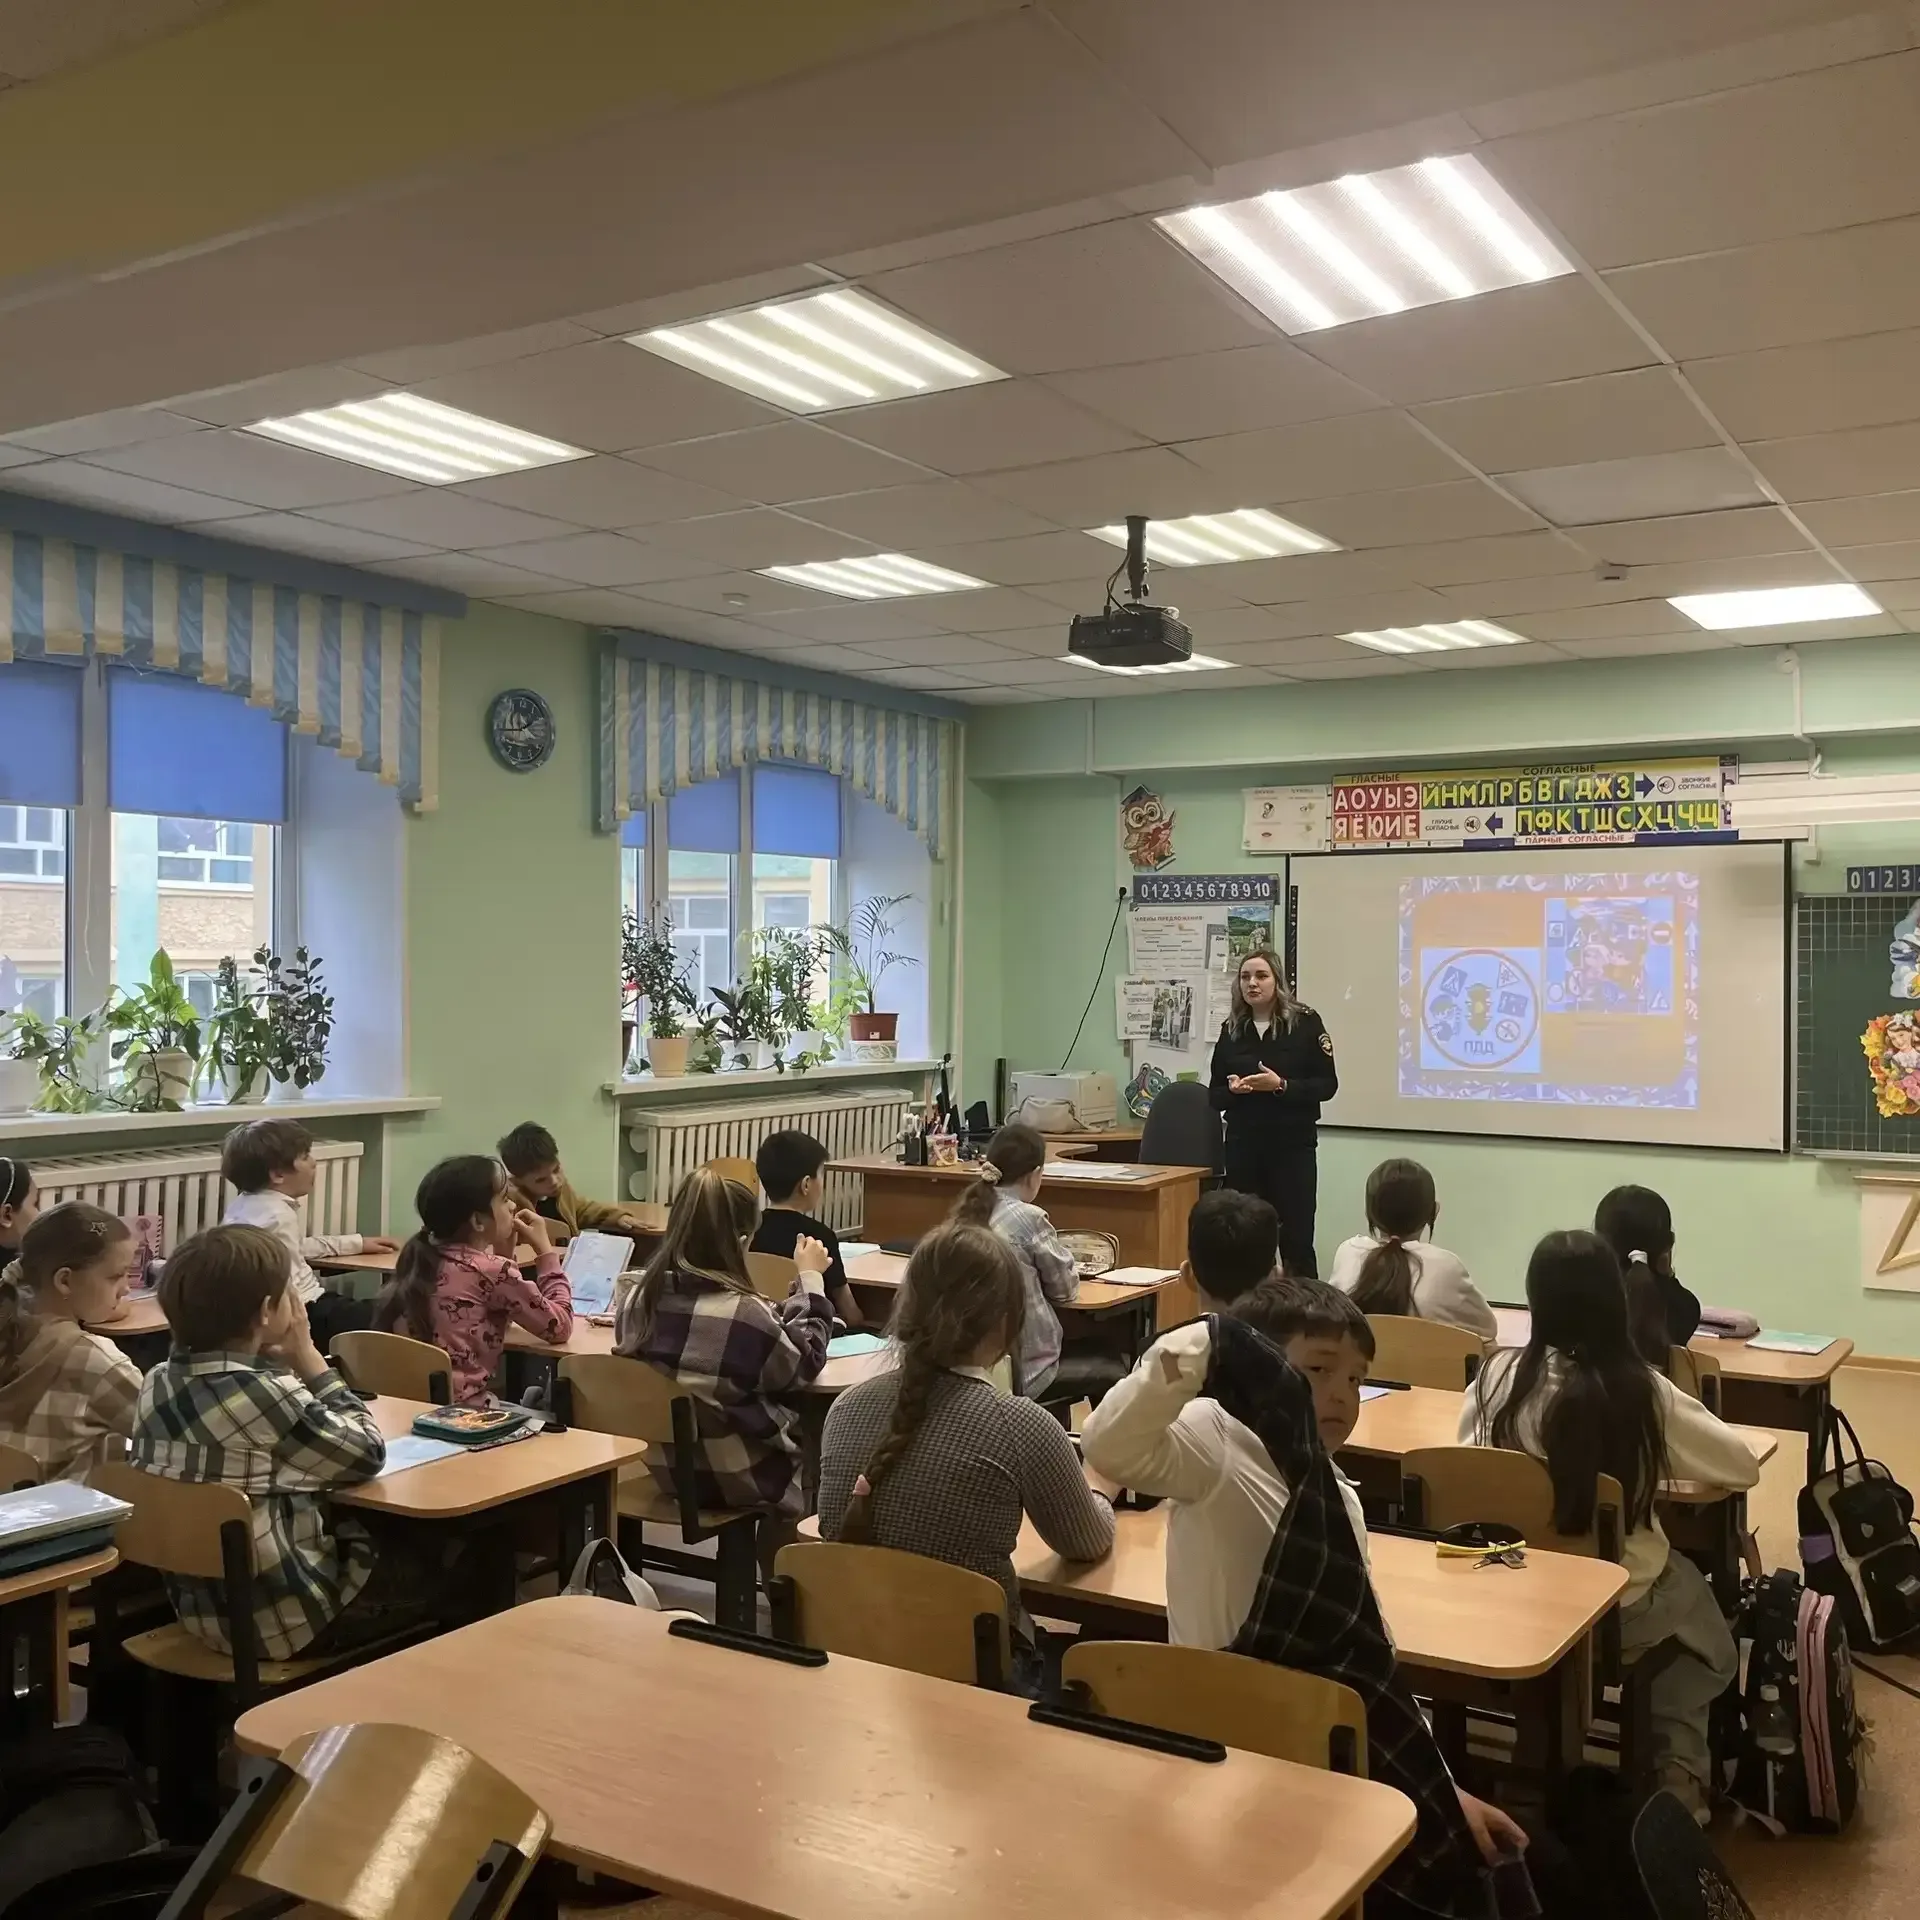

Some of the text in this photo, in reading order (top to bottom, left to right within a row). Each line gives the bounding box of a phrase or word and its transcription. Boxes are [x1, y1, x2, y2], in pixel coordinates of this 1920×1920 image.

[1522, 764, 1597, 776] СОГЛАСНЫЕ
[1351, 774, 1401, 784] ГЛАСНЫЕ
[1677, 782, 1717, 790] СОГЛАСНЫЕ
[1525, 833, 1625, 845] ПАРНЫЕ СОГЛАСНЫЕ
[1464, 1040, 1495, 1056] ПДД
